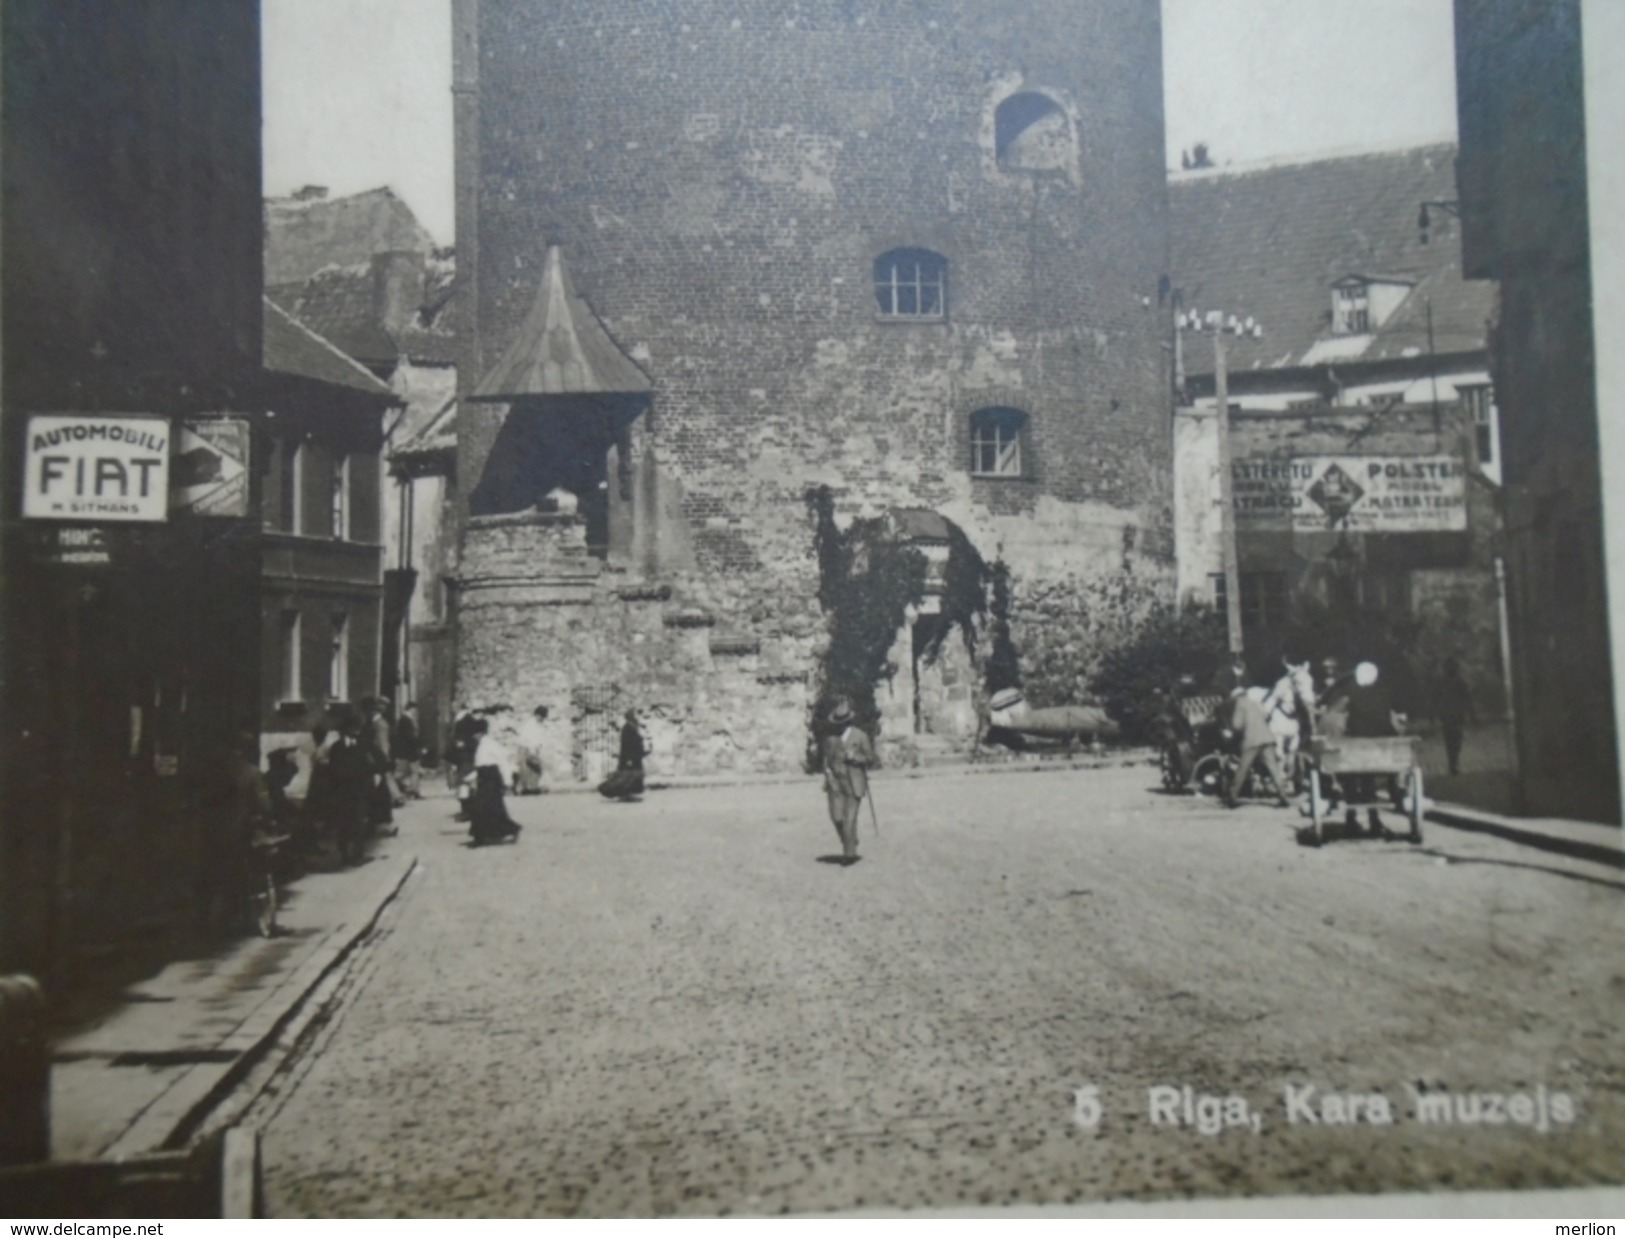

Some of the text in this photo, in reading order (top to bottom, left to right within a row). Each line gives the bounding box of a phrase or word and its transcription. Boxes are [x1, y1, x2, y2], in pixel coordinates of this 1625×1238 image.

[33, 424, 166, 453] AUTOMOBILI
[39, 455, 163, 498] FIAT
[1150, 1084, 1262, 1135] Riga,
[1286, 1084, 1394, 1125] Kara
[1414, 1084, 1576, 1133] muzejs
